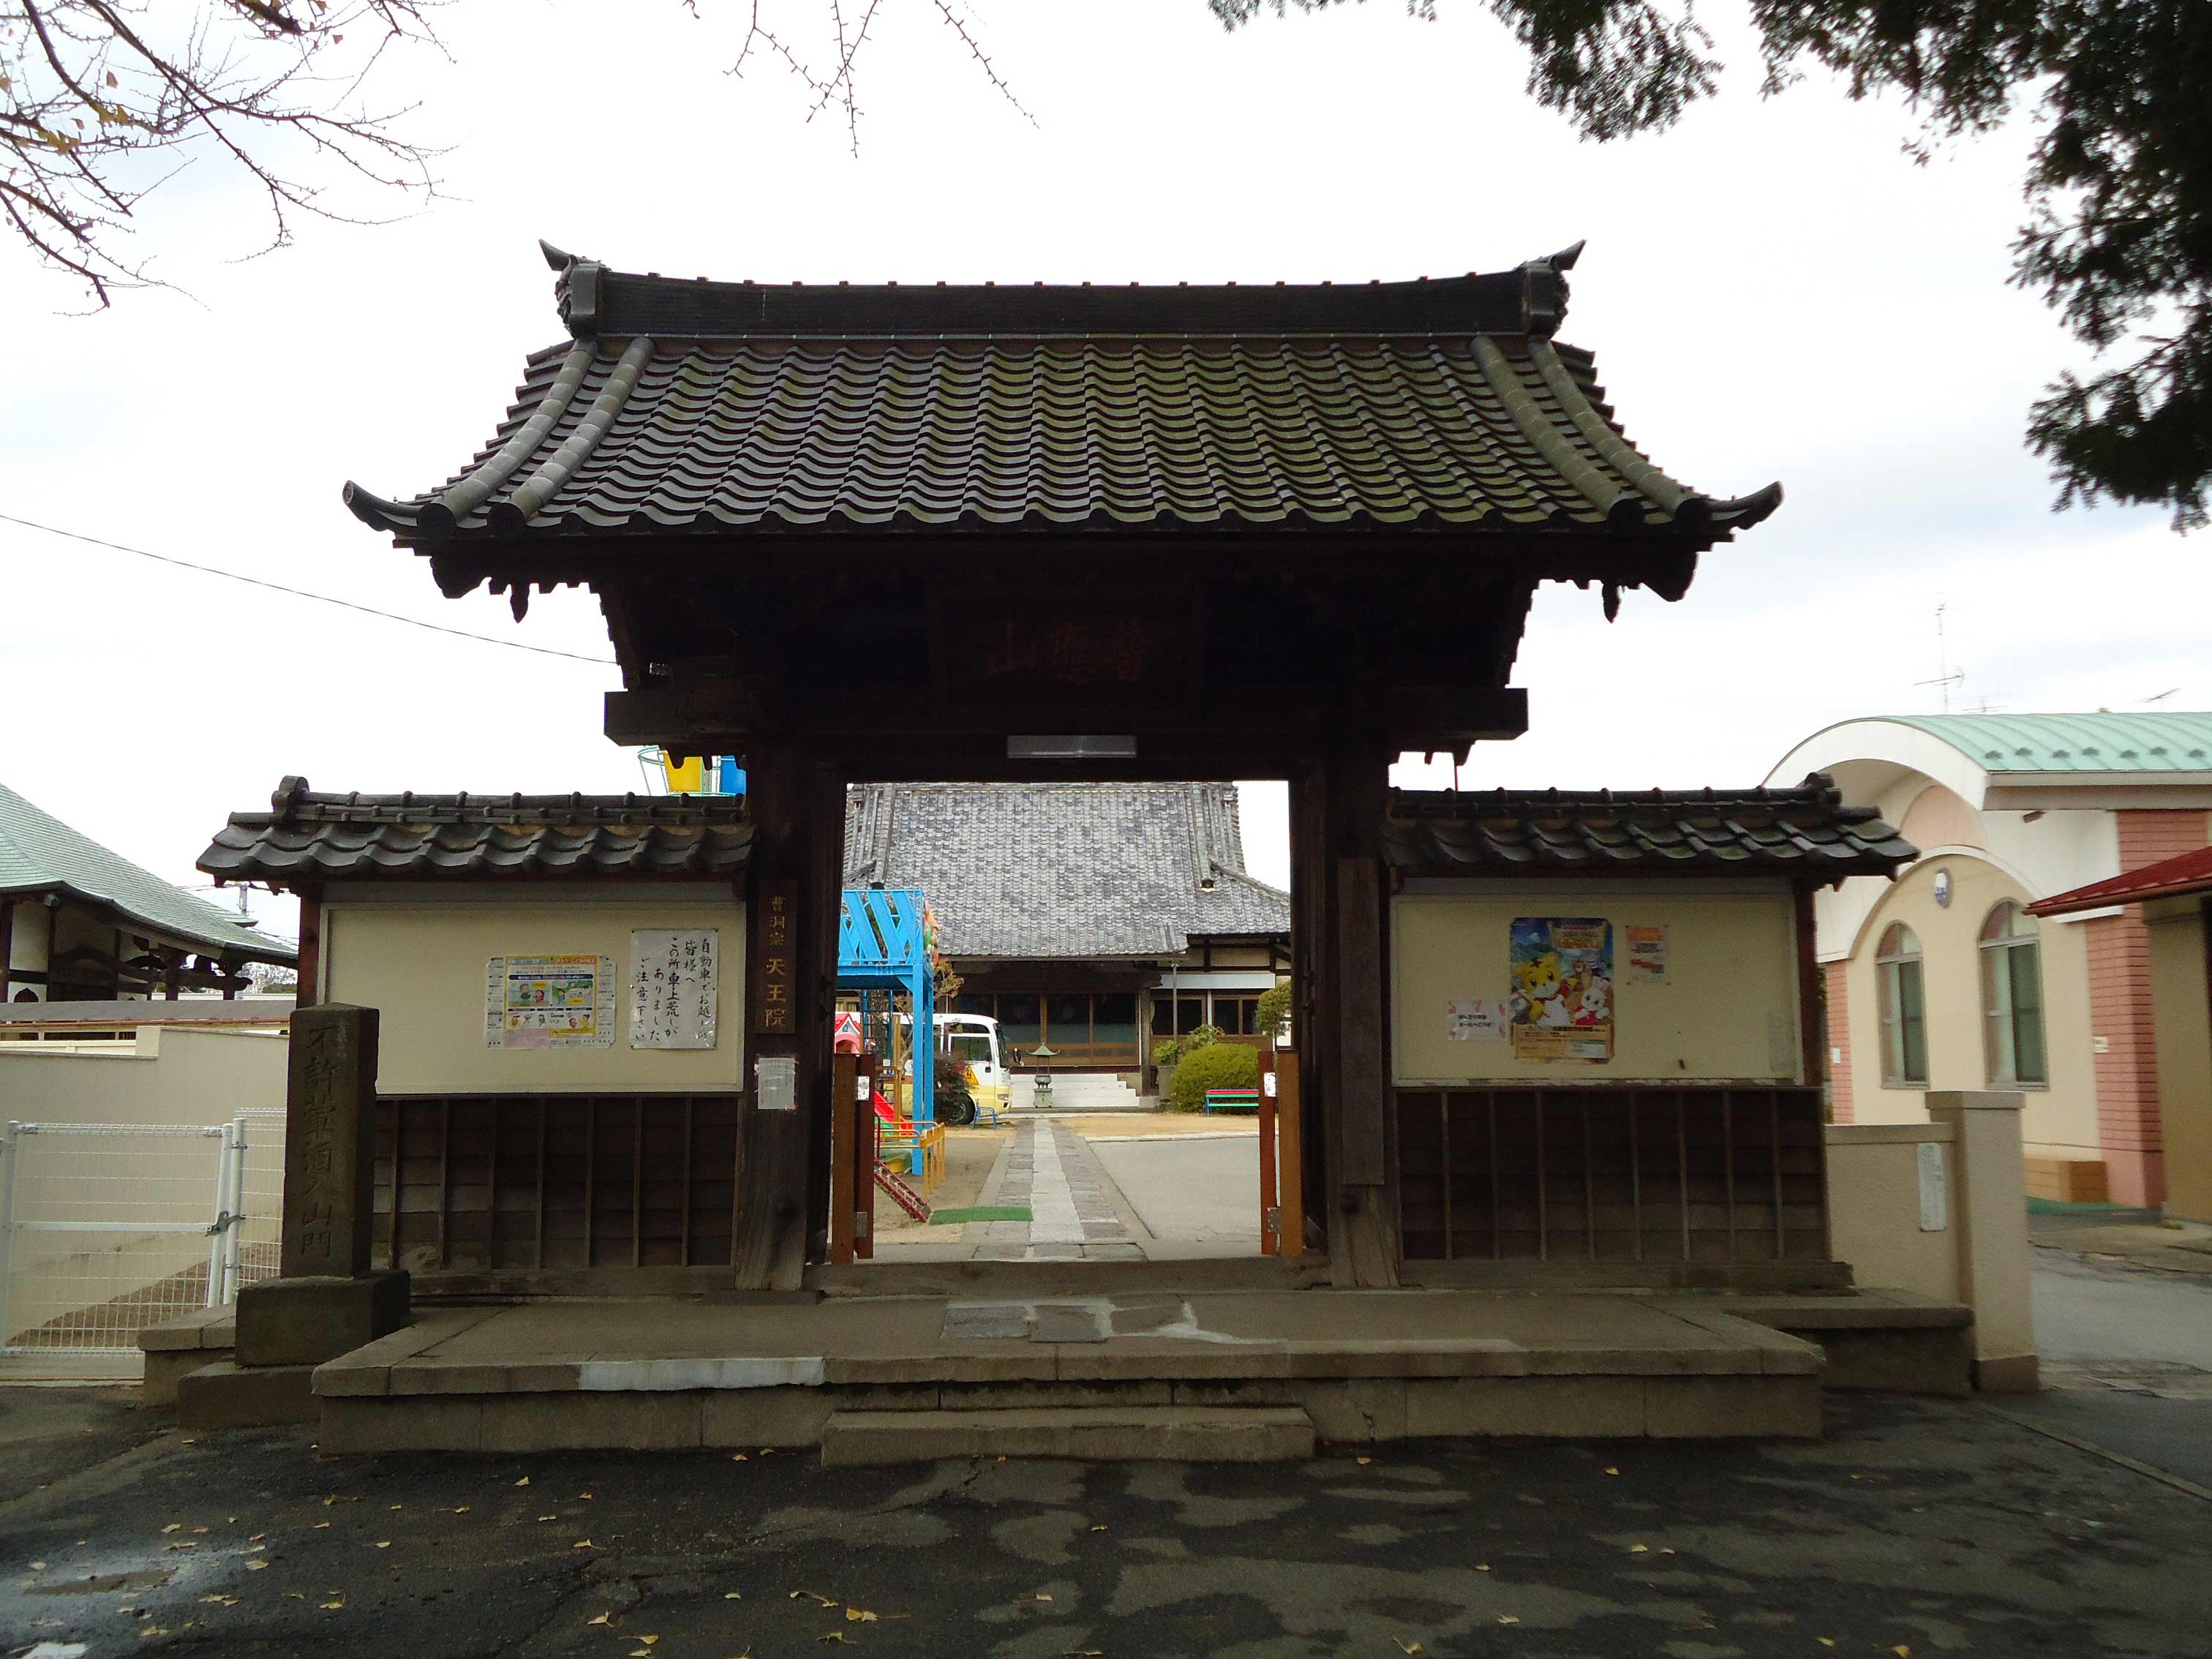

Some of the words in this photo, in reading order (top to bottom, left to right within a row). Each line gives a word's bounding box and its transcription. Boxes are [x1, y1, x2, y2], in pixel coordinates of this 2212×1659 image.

[636, 958, 650, 1039] ご注意下さい
[684, 940, 697, 983] 皆様へ
[650, 968, 663, 1042] ありました
